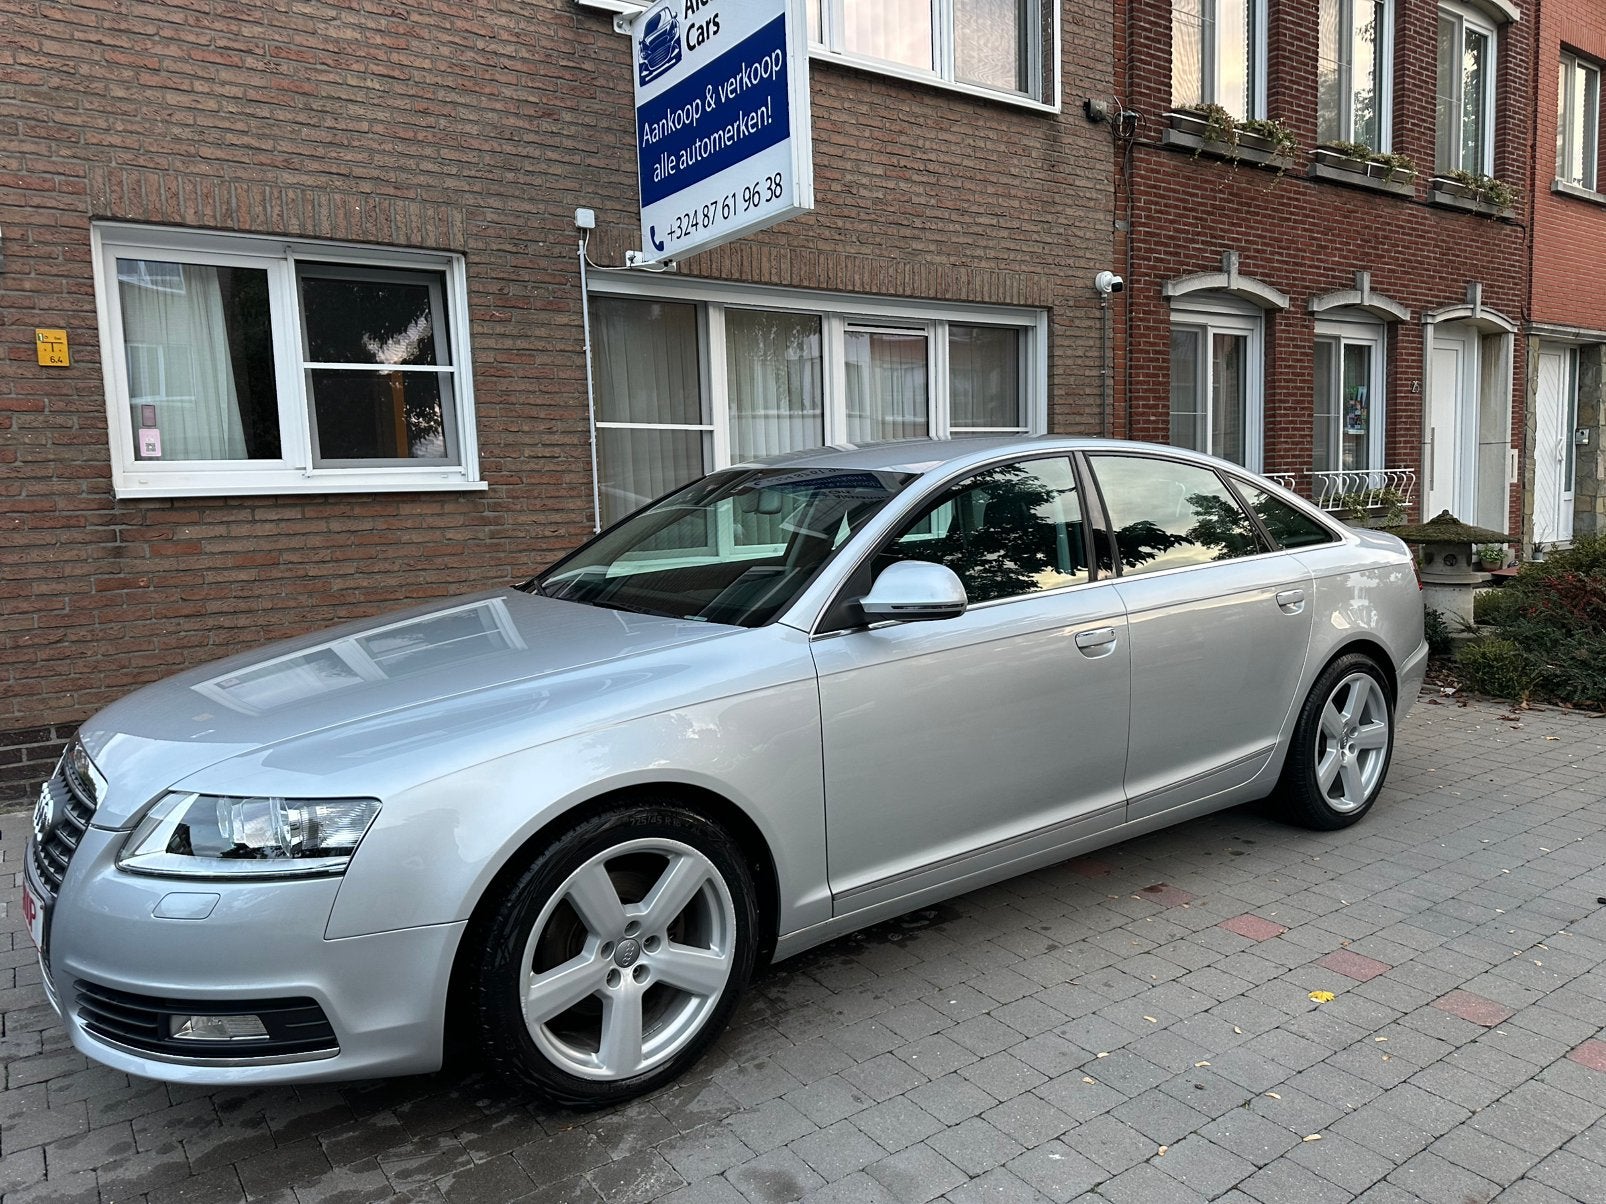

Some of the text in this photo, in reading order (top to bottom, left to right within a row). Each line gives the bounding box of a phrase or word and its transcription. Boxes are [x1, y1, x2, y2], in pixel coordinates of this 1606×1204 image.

[686, 12, 720, 52] Cars
[643, 48, 782, 147] Aankoop & verkoop
[653, 95, 772, 182] alle automerken!
[667, 172, 783, 243] +324 87 61 96 38
